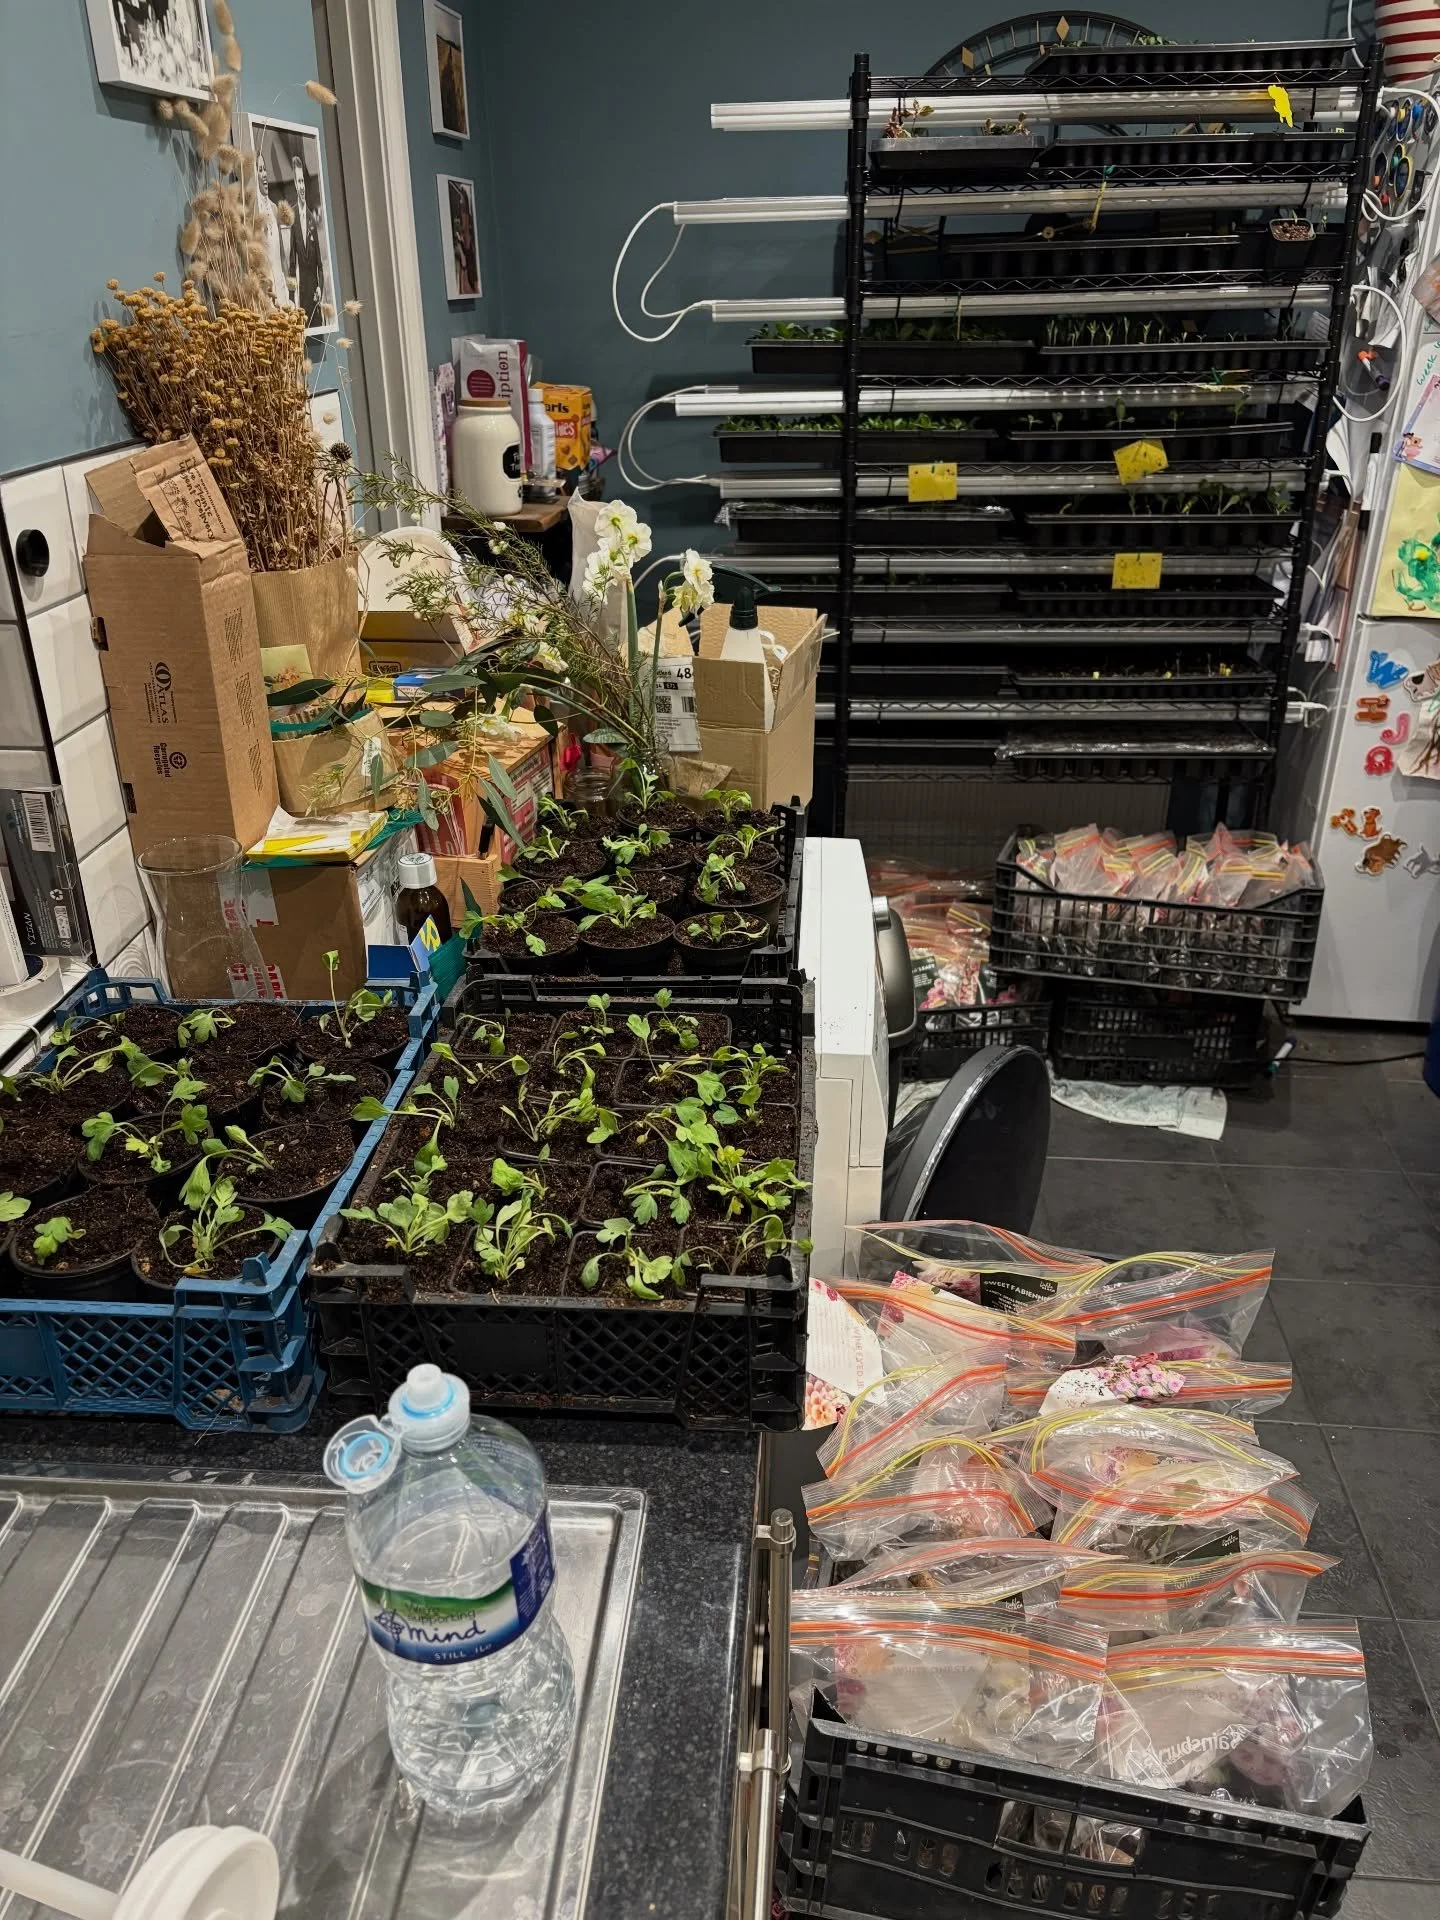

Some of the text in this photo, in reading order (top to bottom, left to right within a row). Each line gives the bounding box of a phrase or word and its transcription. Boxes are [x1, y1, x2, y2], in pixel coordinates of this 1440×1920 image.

[496, 351, 513, 398] iption
[194, 499, 215, 540] Delivery
[676, 667, 692, 679] 48
[157, 683, 169, 724] ATLAS
[153, 745, 163, 775] Recycles
[160, 742, 171, 778] Corrugated
[407, 1620, 486, 1643] mind
[408, 1609, 476, 1625] supporting
[434, 1652, 467, 1661] STILL
